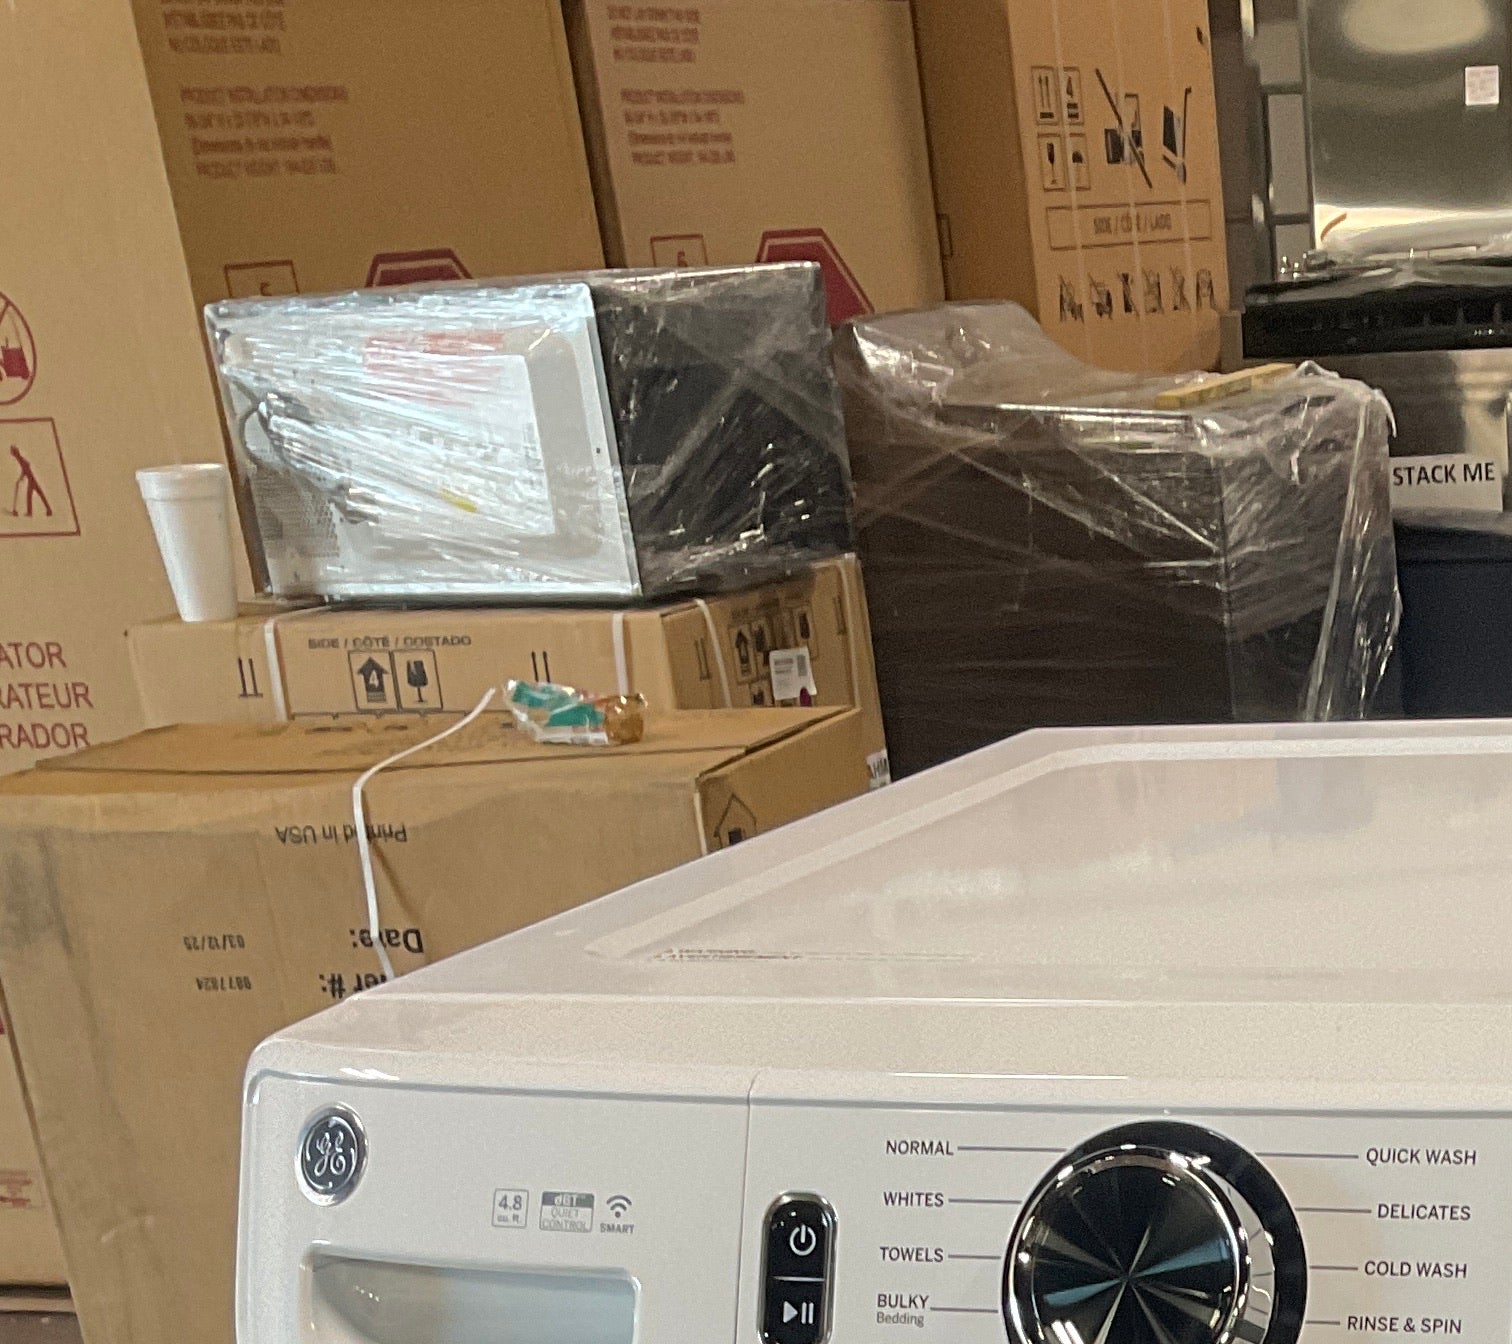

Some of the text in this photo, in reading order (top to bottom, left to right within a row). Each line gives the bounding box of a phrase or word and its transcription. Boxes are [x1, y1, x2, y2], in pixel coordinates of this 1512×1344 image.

[1392, 461, 1496, 487] STACK ME
[0, 681, 95, 711] ATEUR
[274, 824, 408, 845] Printd in USA
[885, 1140, 955, 1156] NORMAL
[1365, 1147, 1477, 1167] QUICK WASH
[498, 1194, 523, 1211] 4.8
[883, 1191, 945, 1208] WHITES
[1377, 1203, 1472, 1221] DELICATES
[600, 1222, 635, 1234] SMART
[879, 1246, 945, 1263] TOWELS
[1364, 1260, 1467, 1278] COLD WASH
[877, 1293, 930, 1310] BULKY
[876, 1311, 925, 1328] Bedding
[1347, 1315, 1462, 1334] RINSE & SPIN
